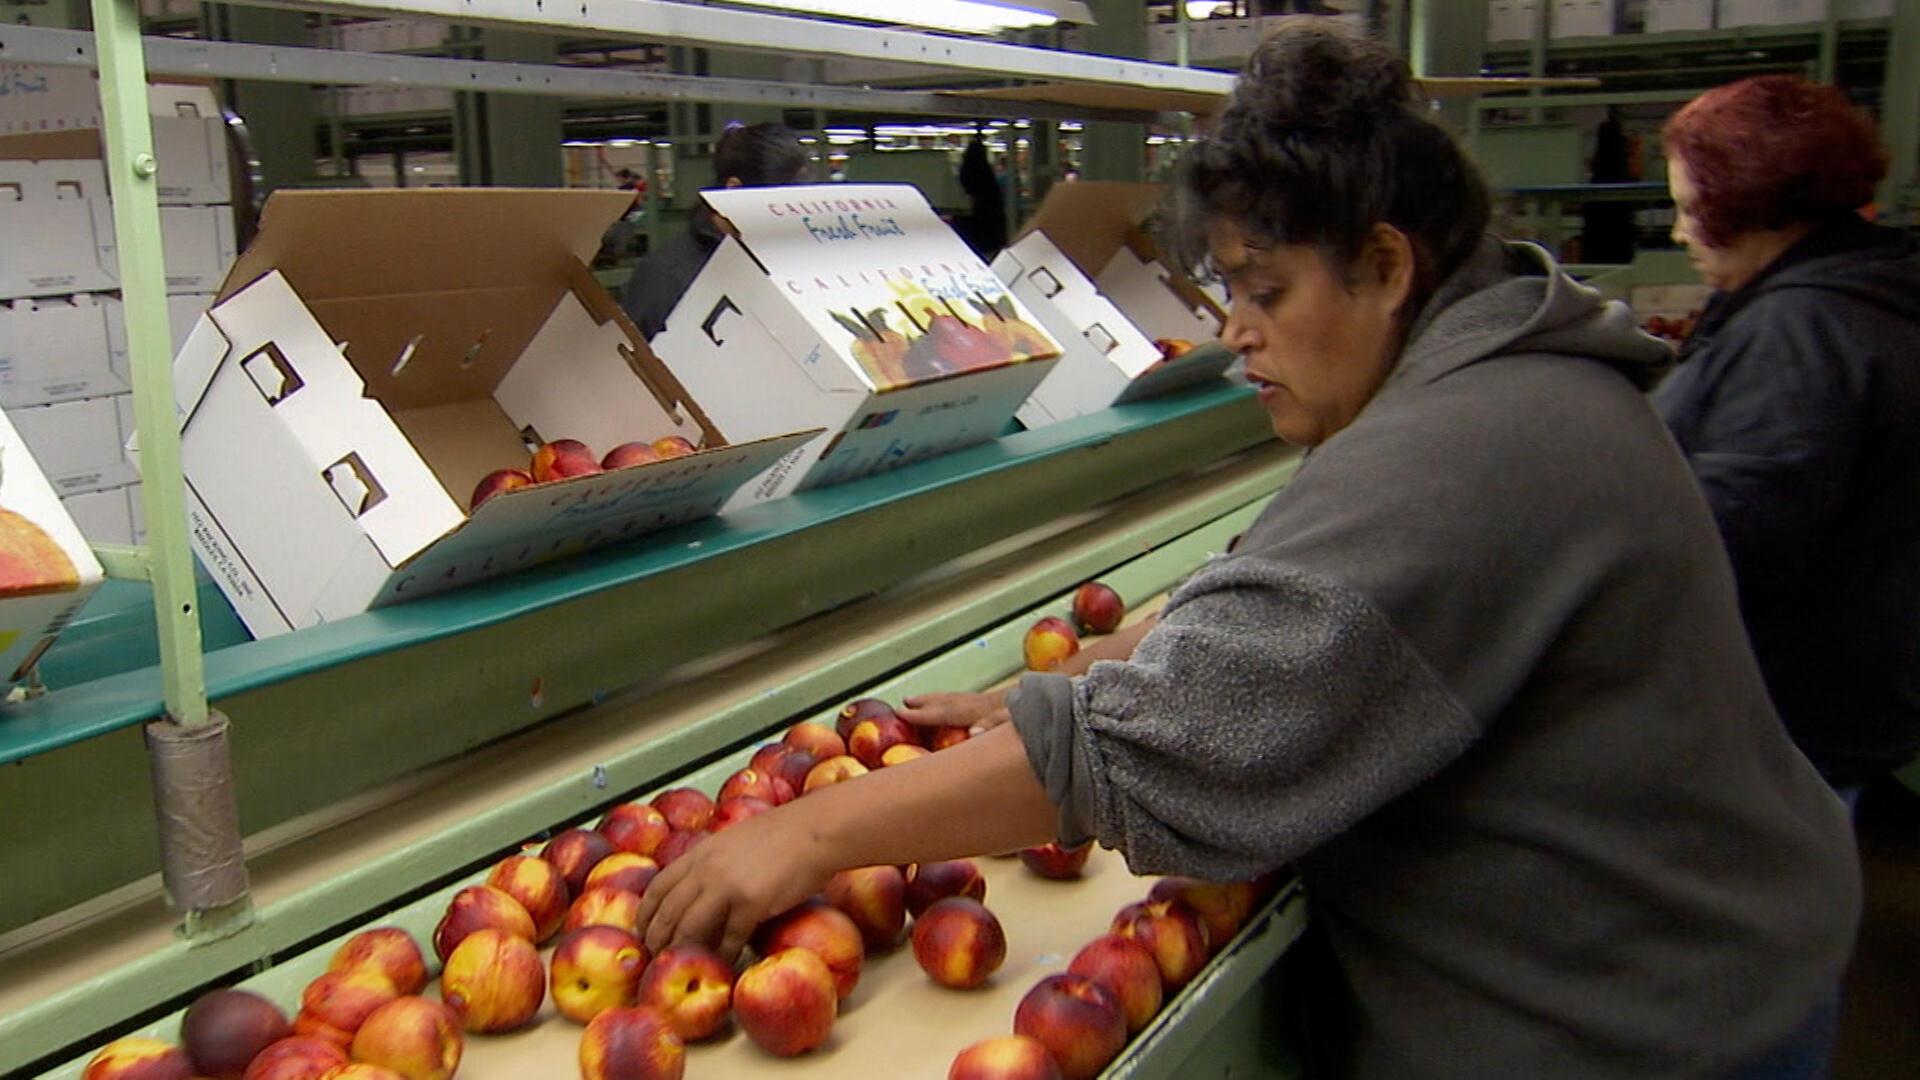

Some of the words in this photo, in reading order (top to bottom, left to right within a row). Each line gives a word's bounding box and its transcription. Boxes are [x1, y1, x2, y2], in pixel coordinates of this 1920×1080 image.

[768, 199, 898, 217] CALIFORNIA
[852, 213, 905, 240] Fruit
[787, 261, 985, 295] CALIFORNIA
